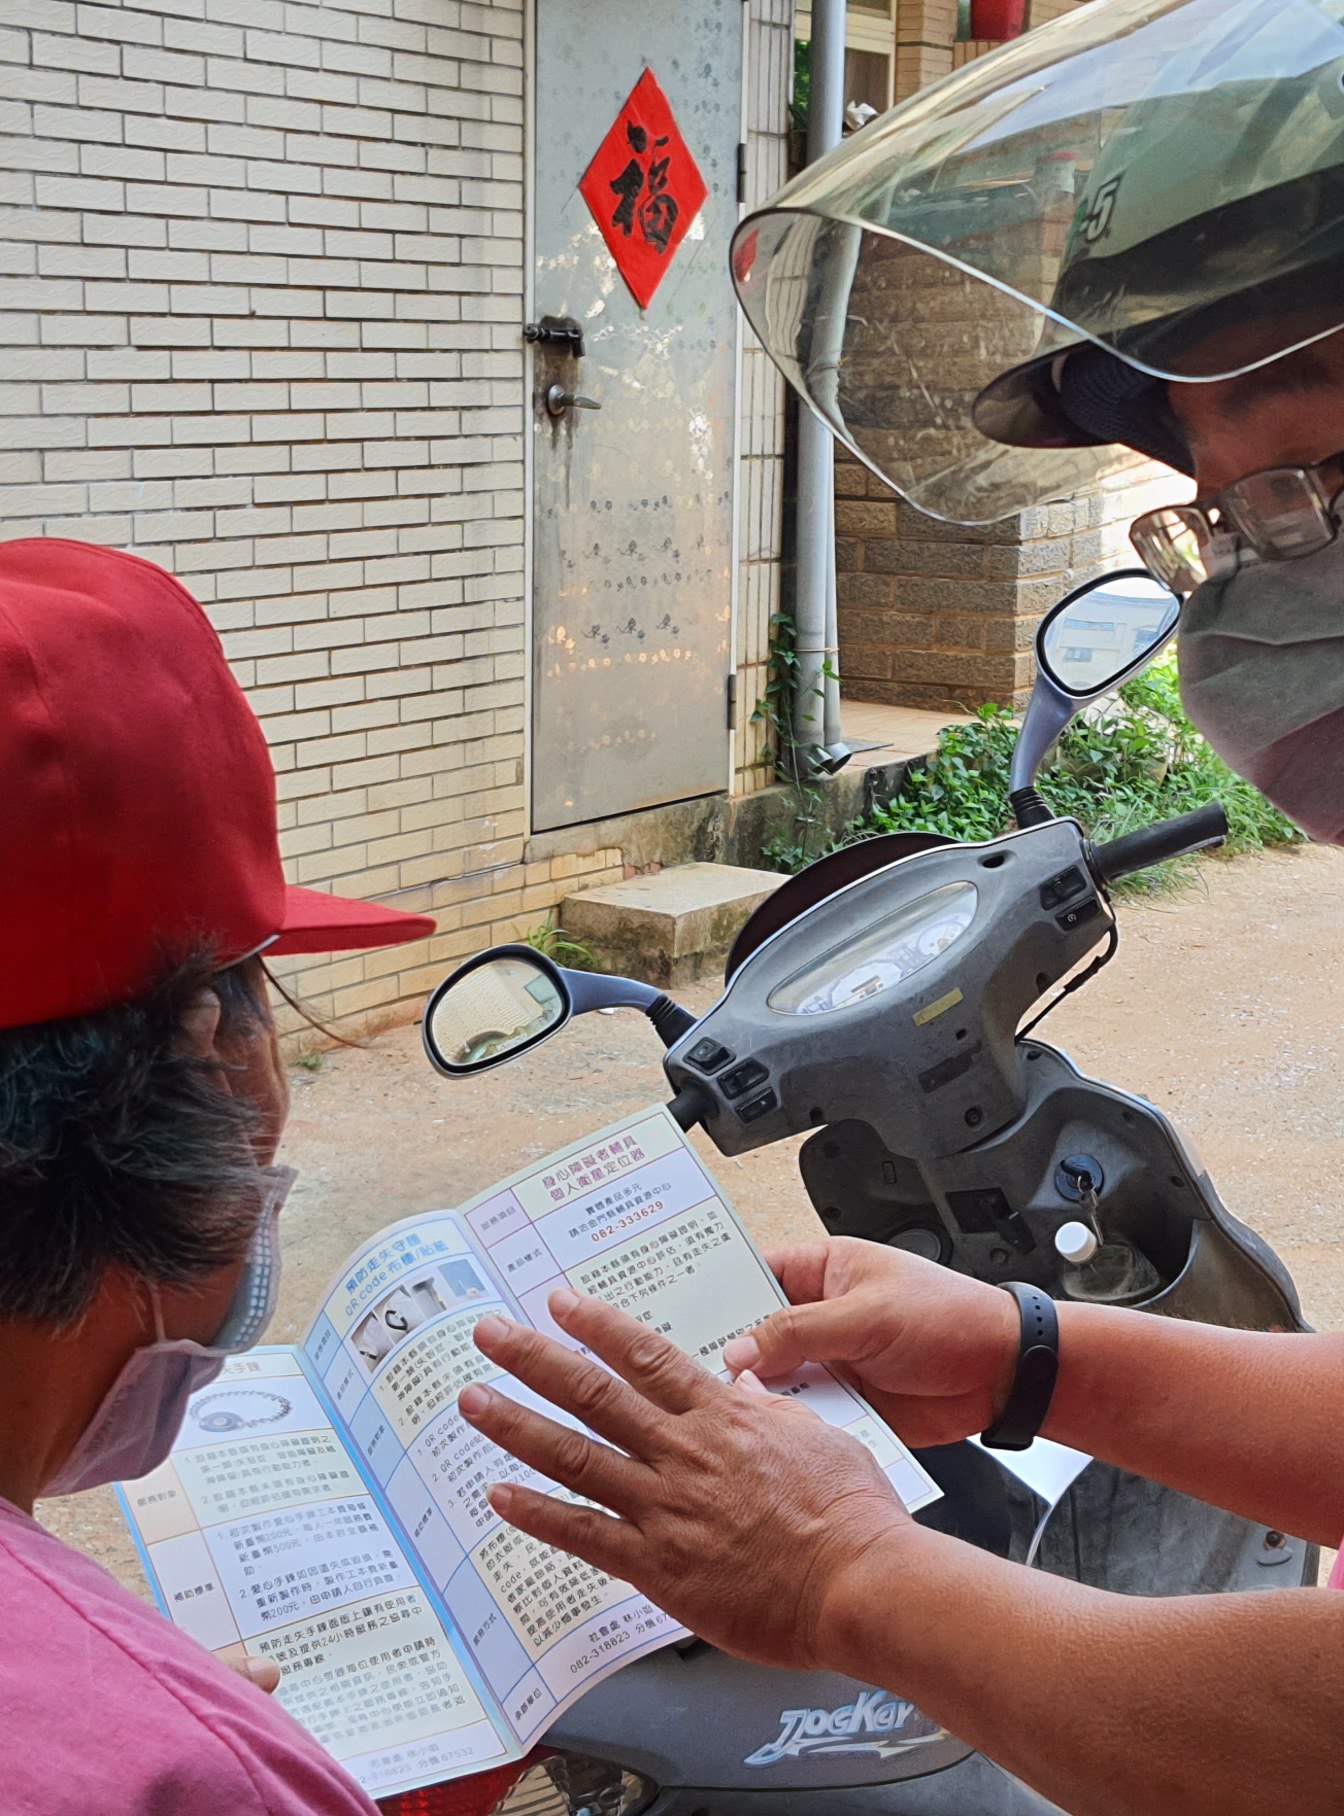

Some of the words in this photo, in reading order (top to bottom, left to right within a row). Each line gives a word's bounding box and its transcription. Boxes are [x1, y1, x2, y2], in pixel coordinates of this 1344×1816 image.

[609, 119, 680, 256] 福
[542, 1135, 638, 1189] 身心障礙者輔具
[549, 1148, 646, 1200] 個人衛星定位器
[360, 1271, 388, 1301] code
[569, 1631, 631, 1674] 082-318823
